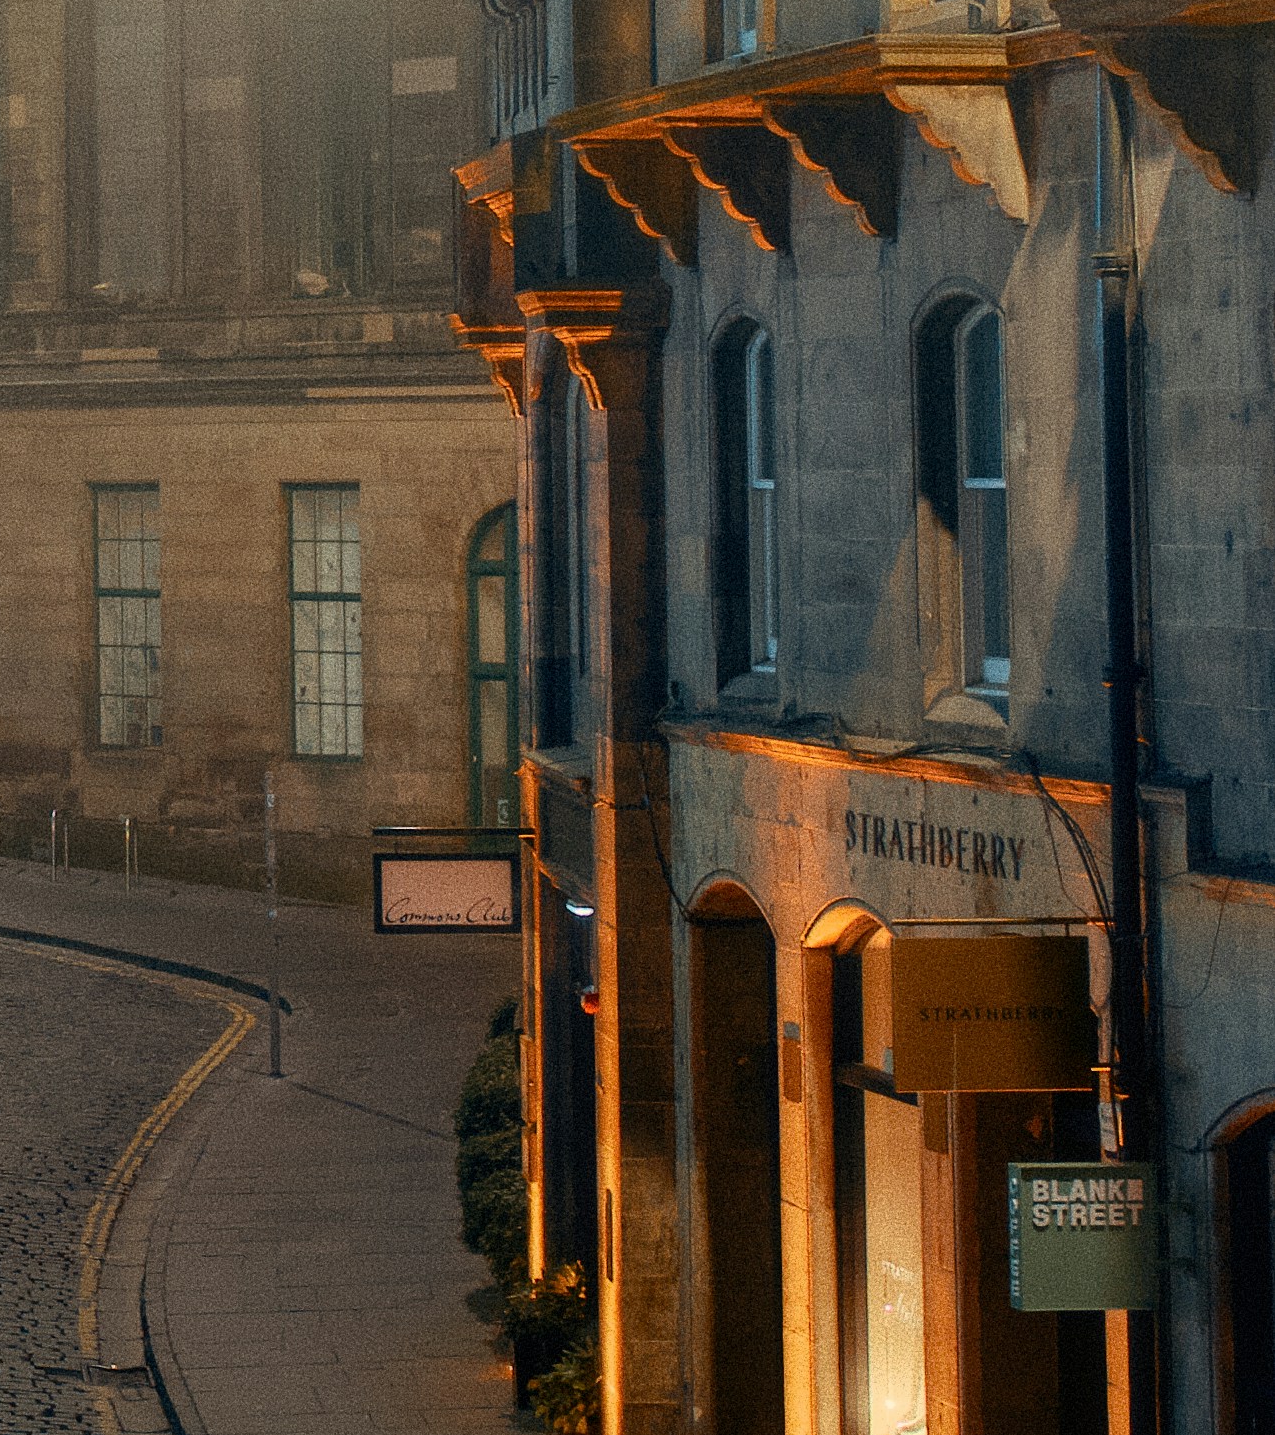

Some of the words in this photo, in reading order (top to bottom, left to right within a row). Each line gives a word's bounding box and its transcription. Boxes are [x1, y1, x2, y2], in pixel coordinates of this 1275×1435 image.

[845, 809, 1025, 881] STRATHBERRY
[385, 897, 461, 923] Commons
[466, 897, 511, 923] Club
[919, 1006, 1066, 1022] STRATHBERRY
[1032, 1178, 1125, 1202] BLANK
[1032, 1203, 1144, 1228] STREET
